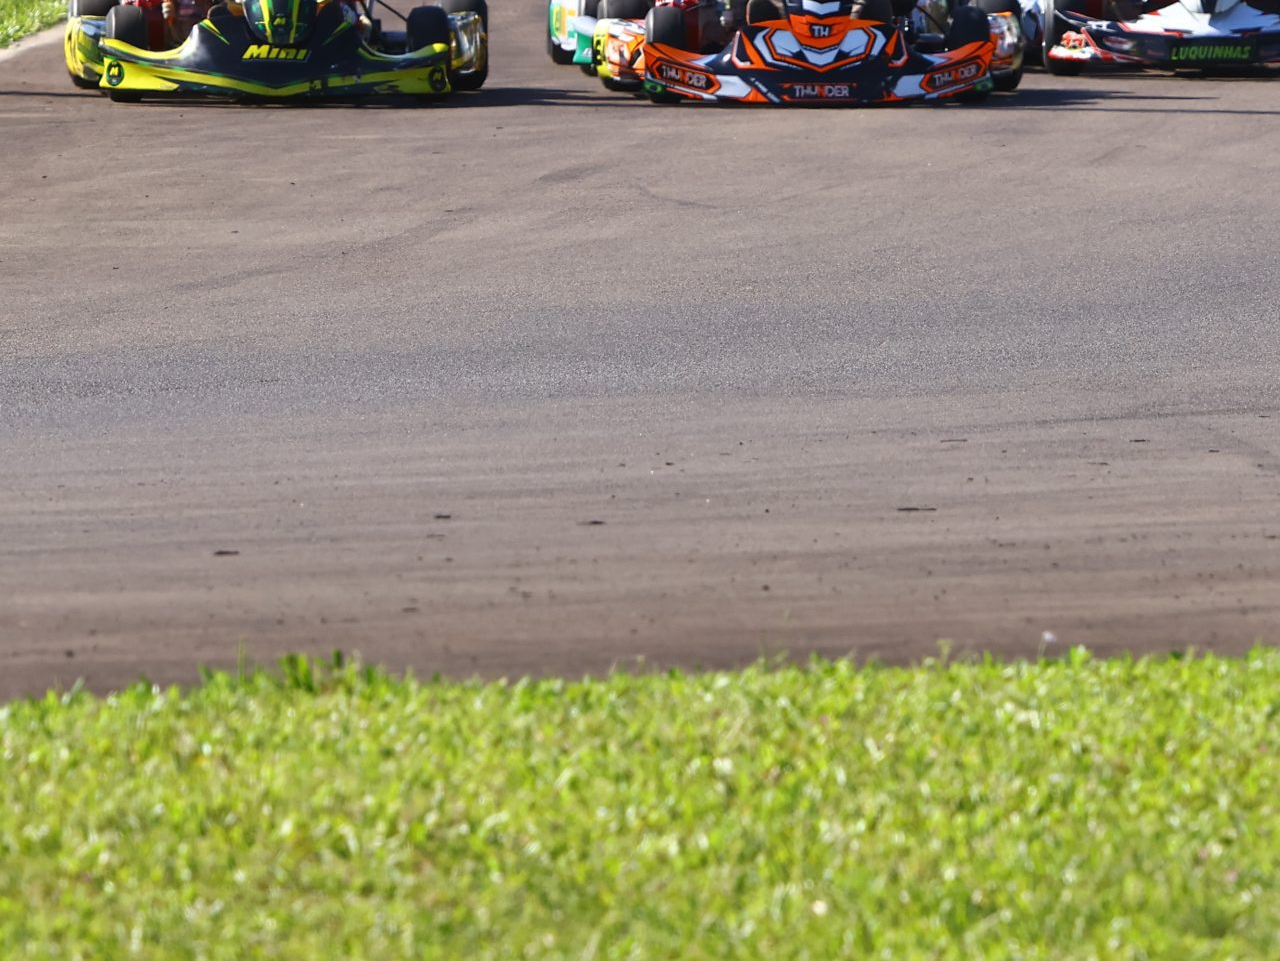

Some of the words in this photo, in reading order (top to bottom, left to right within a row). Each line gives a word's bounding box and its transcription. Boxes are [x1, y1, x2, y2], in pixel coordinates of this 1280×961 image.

[812, 24, 829, 37] TH
[242, 43, 308, 61] Mini
[1171, 45, 1251, 60] LUQUINHAS
[661, 64, 708, 88] THUNDER
[933, 64, 978, 84] THUNDER
[793, 85, 849, 98] THUNDER
